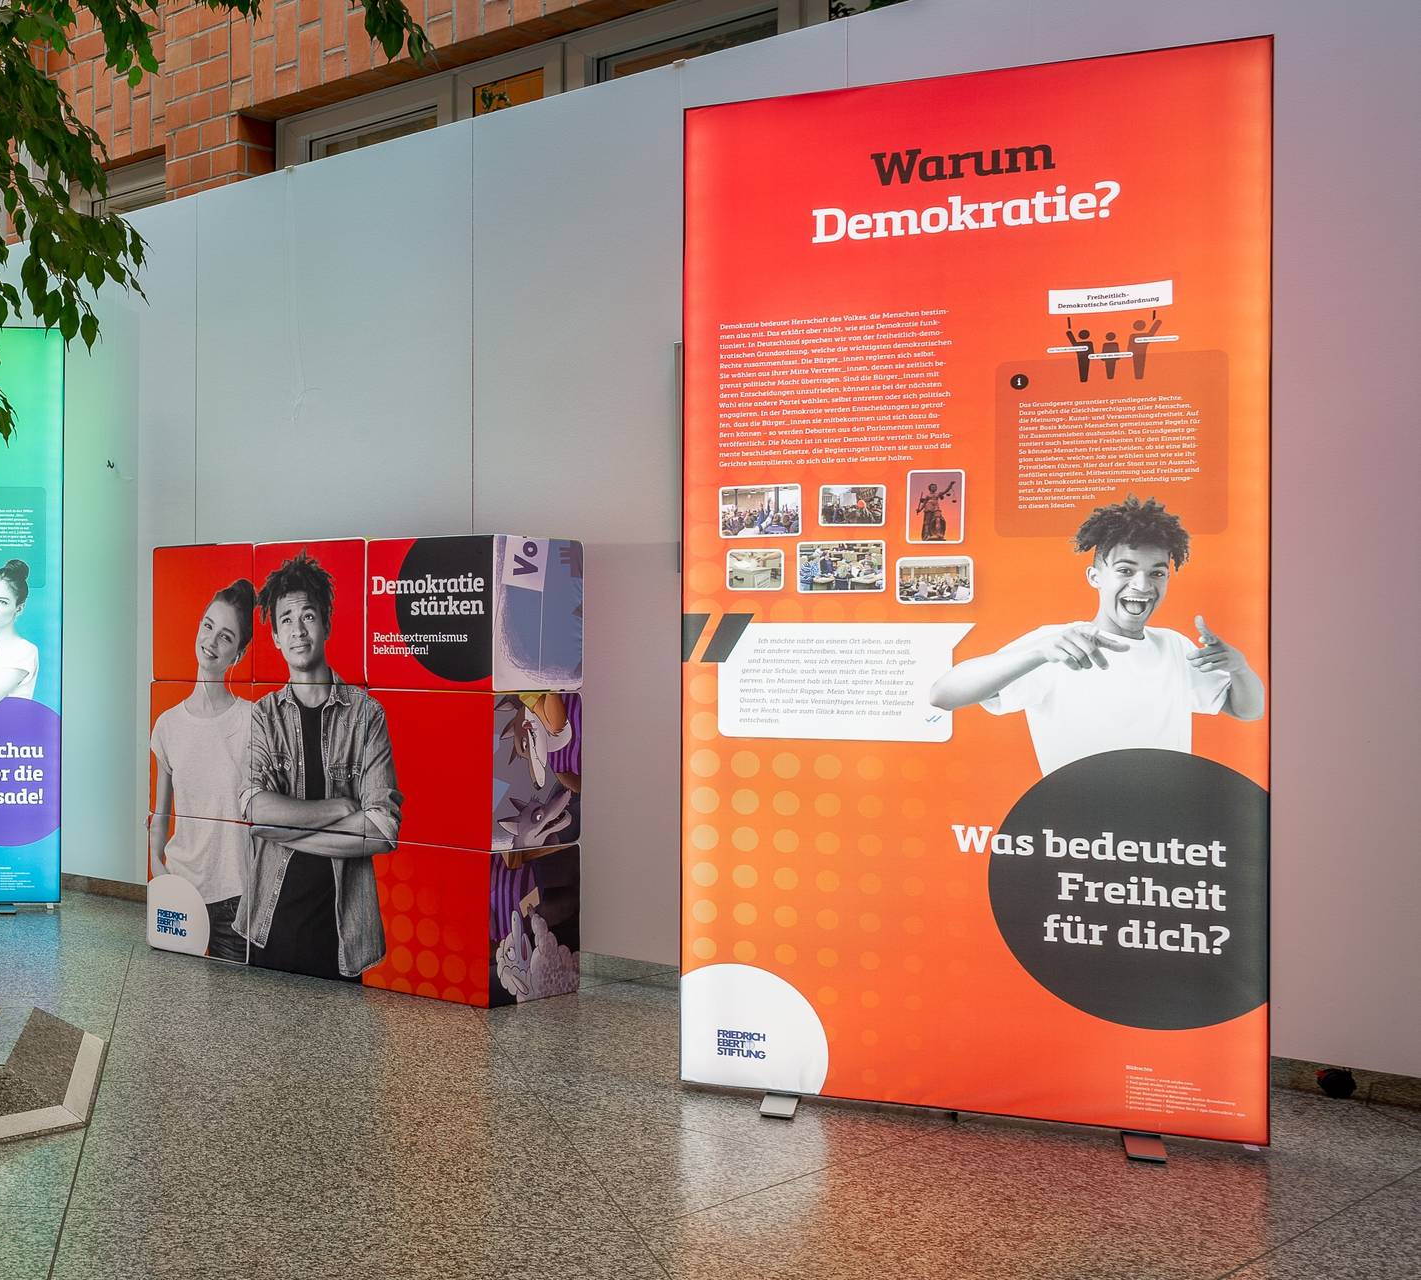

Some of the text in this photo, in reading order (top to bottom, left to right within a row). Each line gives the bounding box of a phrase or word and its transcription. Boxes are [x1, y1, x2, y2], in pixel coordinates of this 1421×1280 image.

[871, 143, 1055, 186] Warum
[811, 180, 1121, 244] Demokratie?
[1057, 295, 1160, 309] Demokratische Grundordnung
[1086, 290, 1130, 300] Freiheitlich-
[719, 308, 950, 330] Demokratie bedeutet Herrschaft des Volkes, die Menschen bestim-
[734, 330, 751, 339] also
[750, 329, 766, 338] mit.
[764, 329, 780, 337] Das
[780, 327, 805, 336] erklärt
[804, 326, 822, 334] aber
[822, 325, 843, 335] nicht,
[844, 324, 858, 332] wie
[858, 323, 875, 331] eine
[875, 320, 919, 330] Demokratie
[919, 319, 941, 327] funk-
[719, 341, 747, 349] tioniert.
[747, 340, 756, 348] In
[755, 337, 800, 347] Deutschland
[800, 335, 833, 346] sprechen
[833, 335, 847, 343] wir
[862, 333, 875, 341] der
[875, 329, 943, 340] freiheitlich-demo-
[1018, 394, 1183, 409] Das Grundgesetz garantiert grundlegende Rechte.
[1018, 408, 1036, 416] Dazu
[1035, 407, 1059, 417] gehört
[1069, 404, 1137, 415] Gleichberechtigung
[1153, 402, 1191, 412] Menschen,
[1018, 416, 1029, 424] die
[1029, 415, 1068, 425] Meinungs-,
[1067, 414, 1091, 422] Kunst-
[1090, 413, 1106, 421] und
[1105, 410, 1186, 422] Versammlungsfreiheit.
[371, 573, 484, 595] Demokratie
[410, 597, 484, 616] stärken
[373, 632, 468, 643] Rechtsextremismus
[795, 637, 814, 645] nicht
[824, 637, 848, 645] einem
[848, 637, 860, 645] Ort
[860, 637, 882, 647] leben,
[893, 637, 911, 645] dem
[373, 643, 429, 656] bekämpfen!
[14, 765, 43, 782] die
[951, 825, 1227, 867] Was bedeutet
[1058, 872, 1227, 911] Freiheit
[157, 908, 187, 921] FRIEDRICH
[157, 917, 175, 927] EBERT
[156, 925, 187, 937] STIFTUNG
[1043, 915, 1230, 955] für dich?
[717, 1029, 766, 1041] FRIEDRICH
[717, 1038, 746, 1048] EBERT
[717, 1047, 766, 1060] STIFTUNG
